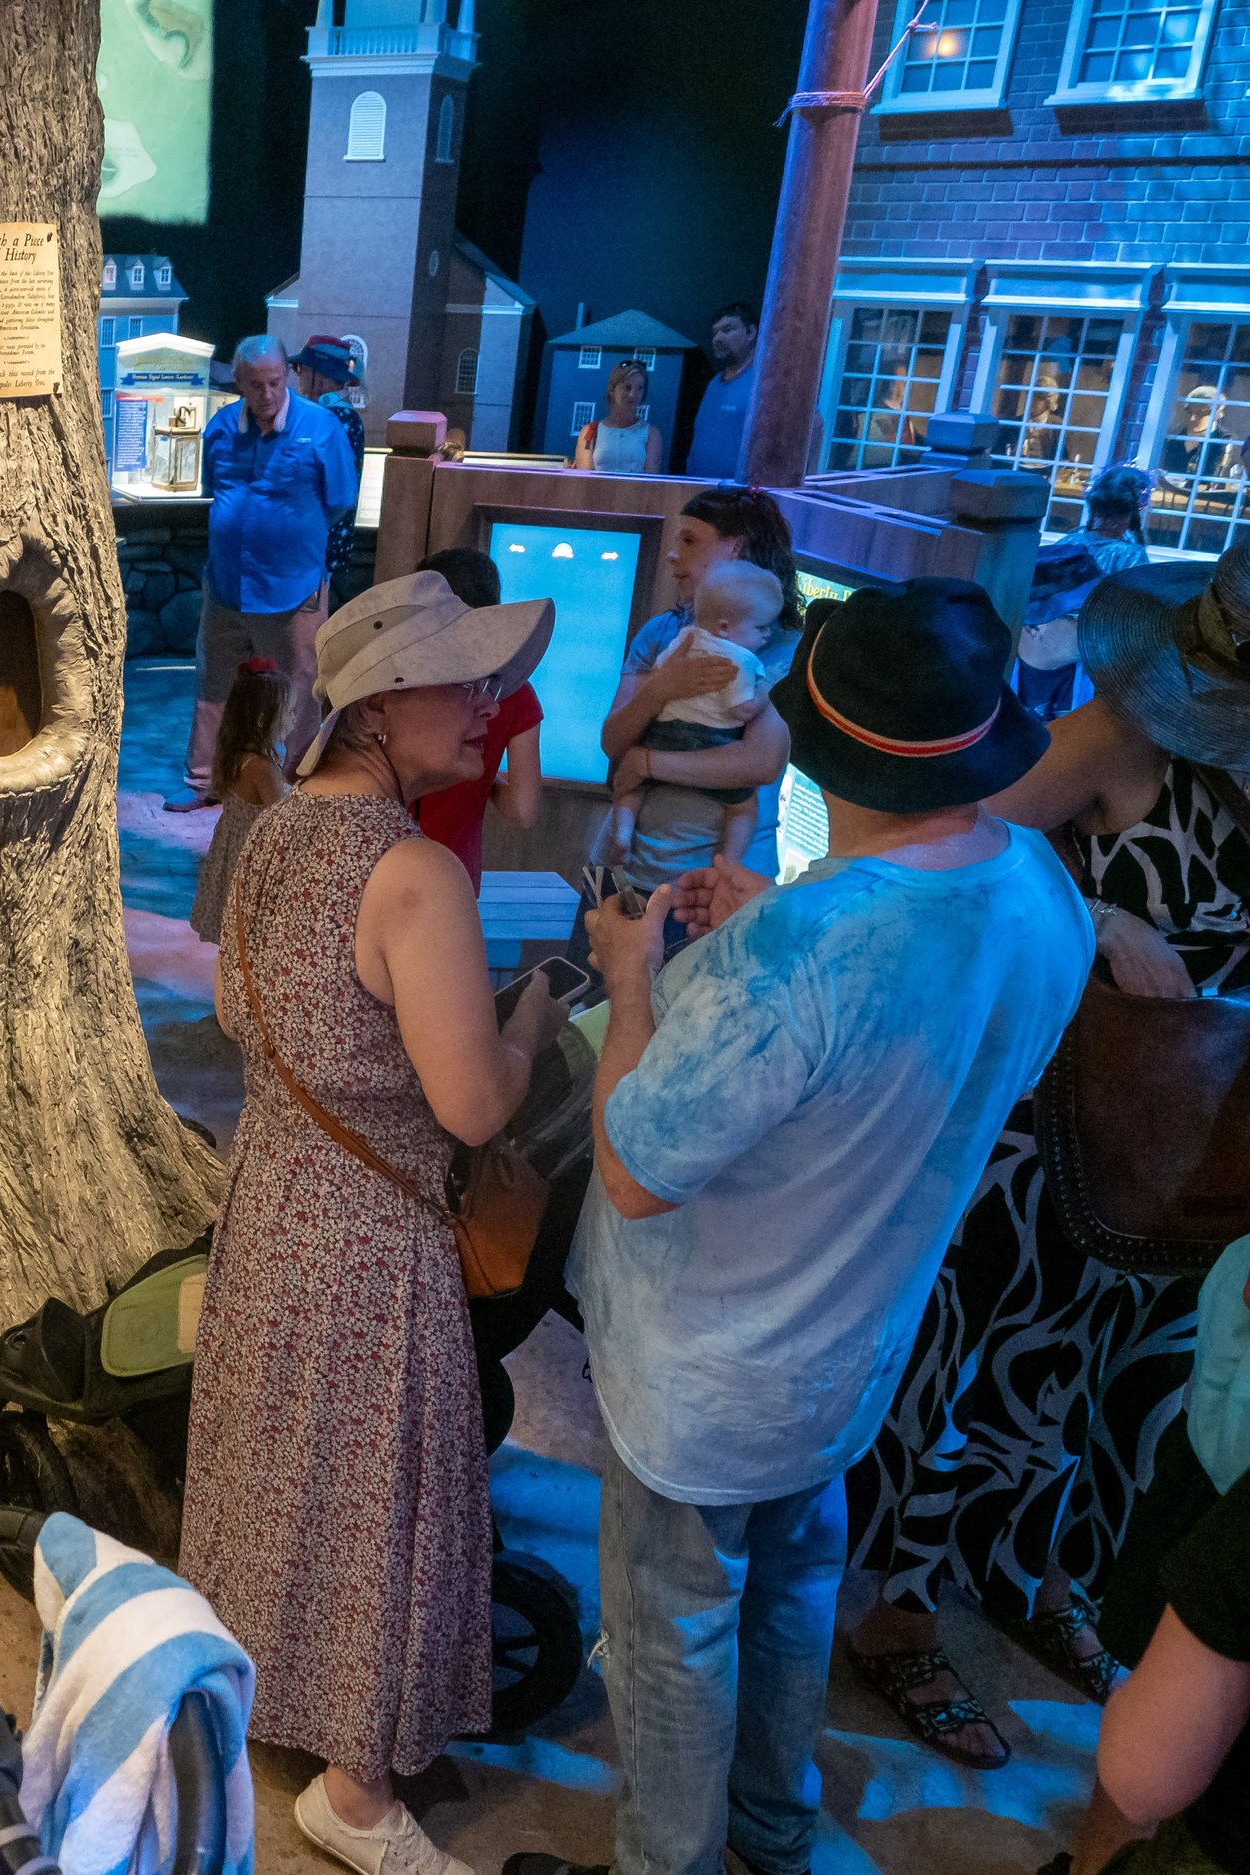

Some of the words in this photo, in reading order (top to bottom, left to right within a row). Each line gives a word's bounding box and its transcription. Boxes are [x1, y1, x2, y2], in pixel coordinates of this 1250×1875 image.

[12, 238, 19, 247] a
[24, 234, 44, 247] Piece
[4, 248, 37, 264] History
[35, 369, 46, 377] from
